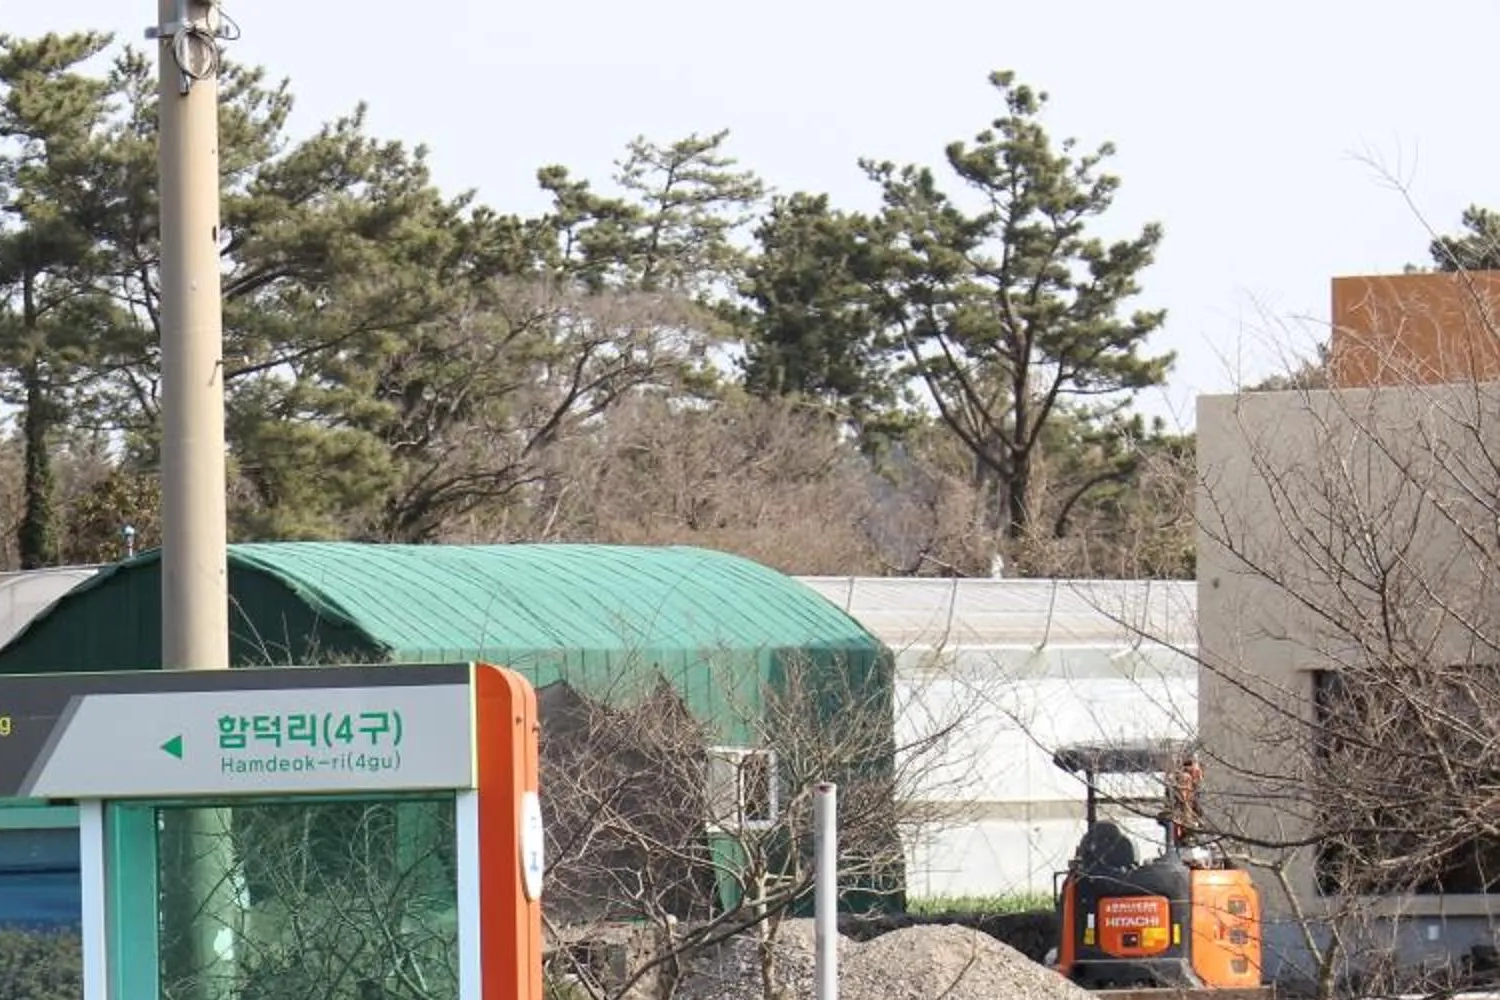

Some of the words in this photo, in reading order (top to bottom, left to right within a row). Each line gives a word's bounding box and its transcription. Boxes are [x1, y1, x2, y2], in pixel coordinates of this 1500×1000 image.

[217, 709, 403, 749] 함덕리(4구)
[221, 750, 402, 774] Hamdeok-ri(4gu)
[1104, 915, 1160, 928] HITACHI
